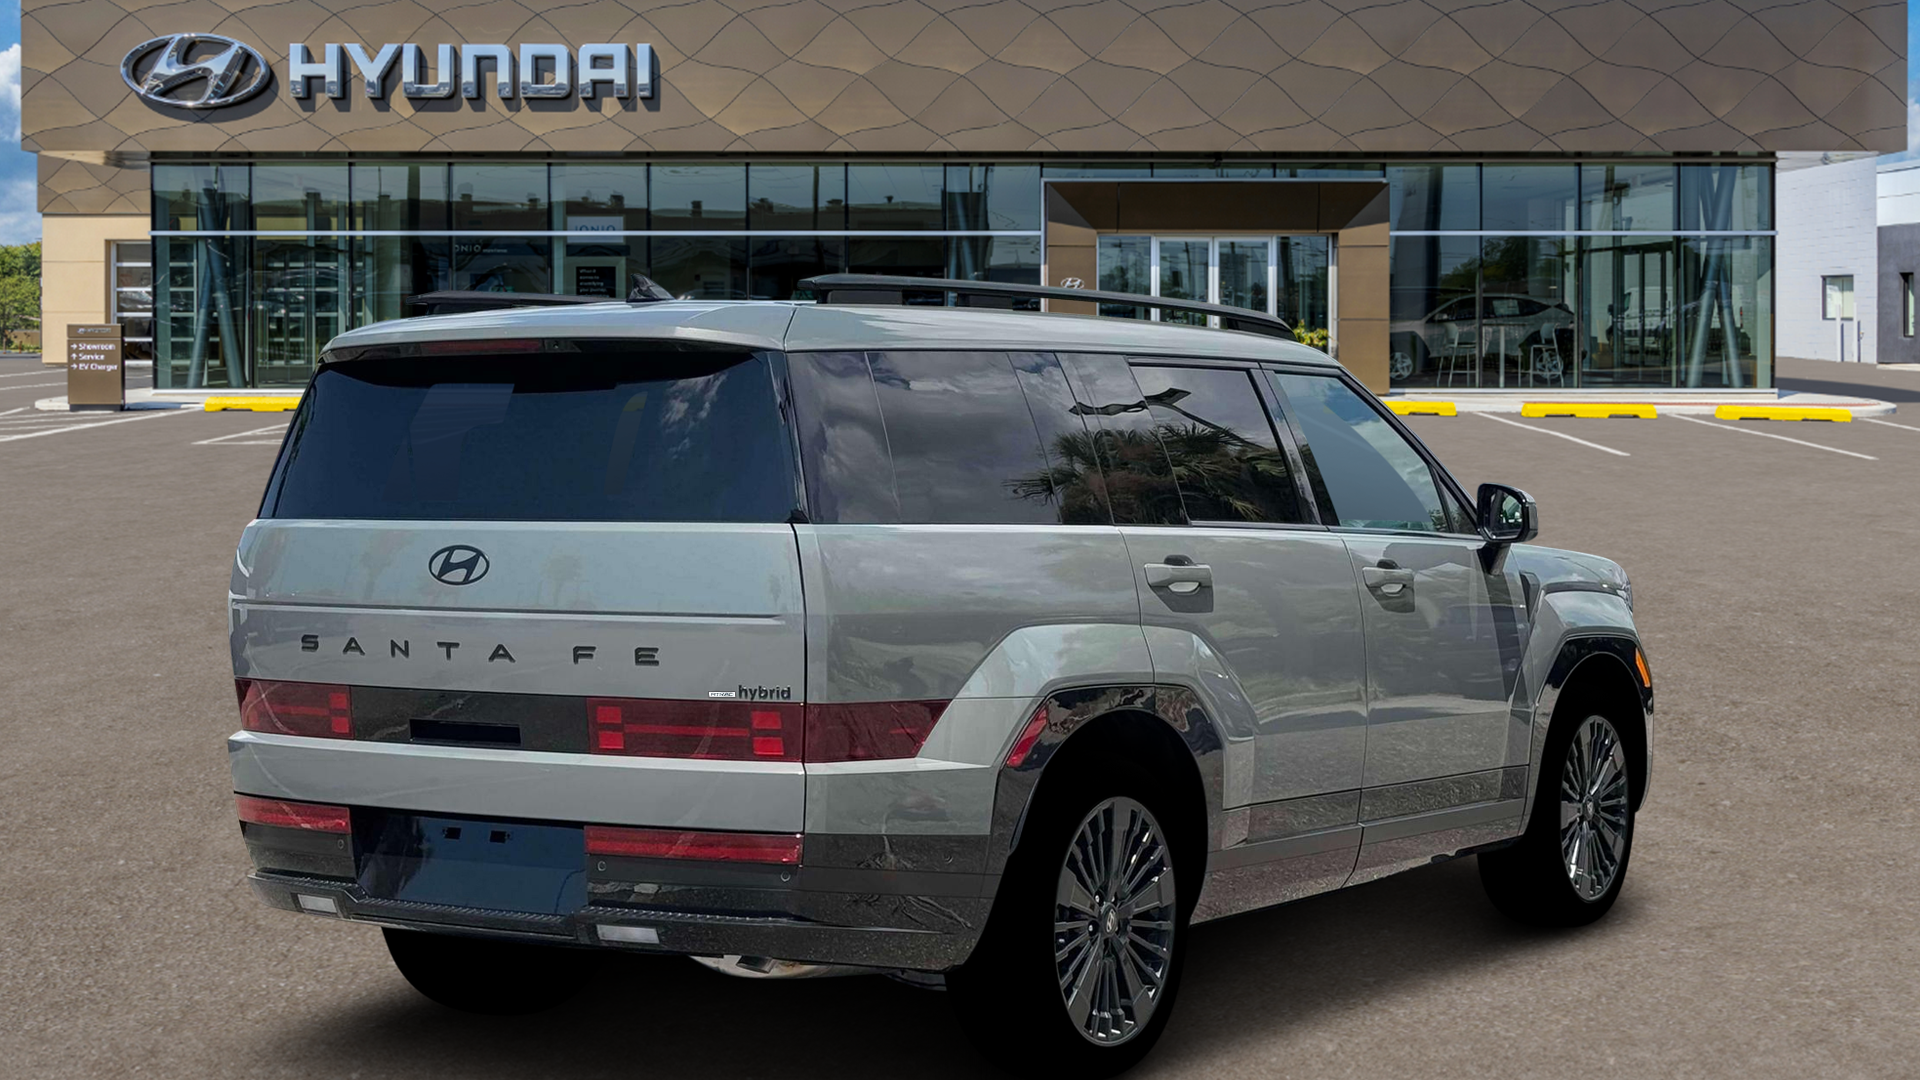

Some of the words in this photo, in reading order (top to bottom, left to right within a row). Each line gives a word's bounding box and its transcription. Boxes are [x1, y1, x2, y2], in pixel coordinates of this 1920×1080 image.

[289, 43, 654, 99] HYUNDAI
[78, 352, 105, 360] Service
[90, 363, 118, 372] Charger
[301, 634, 516, 663] SANTA
[573, 645, 660, 667] FE
[738, 684, 791, 701] hybrid
